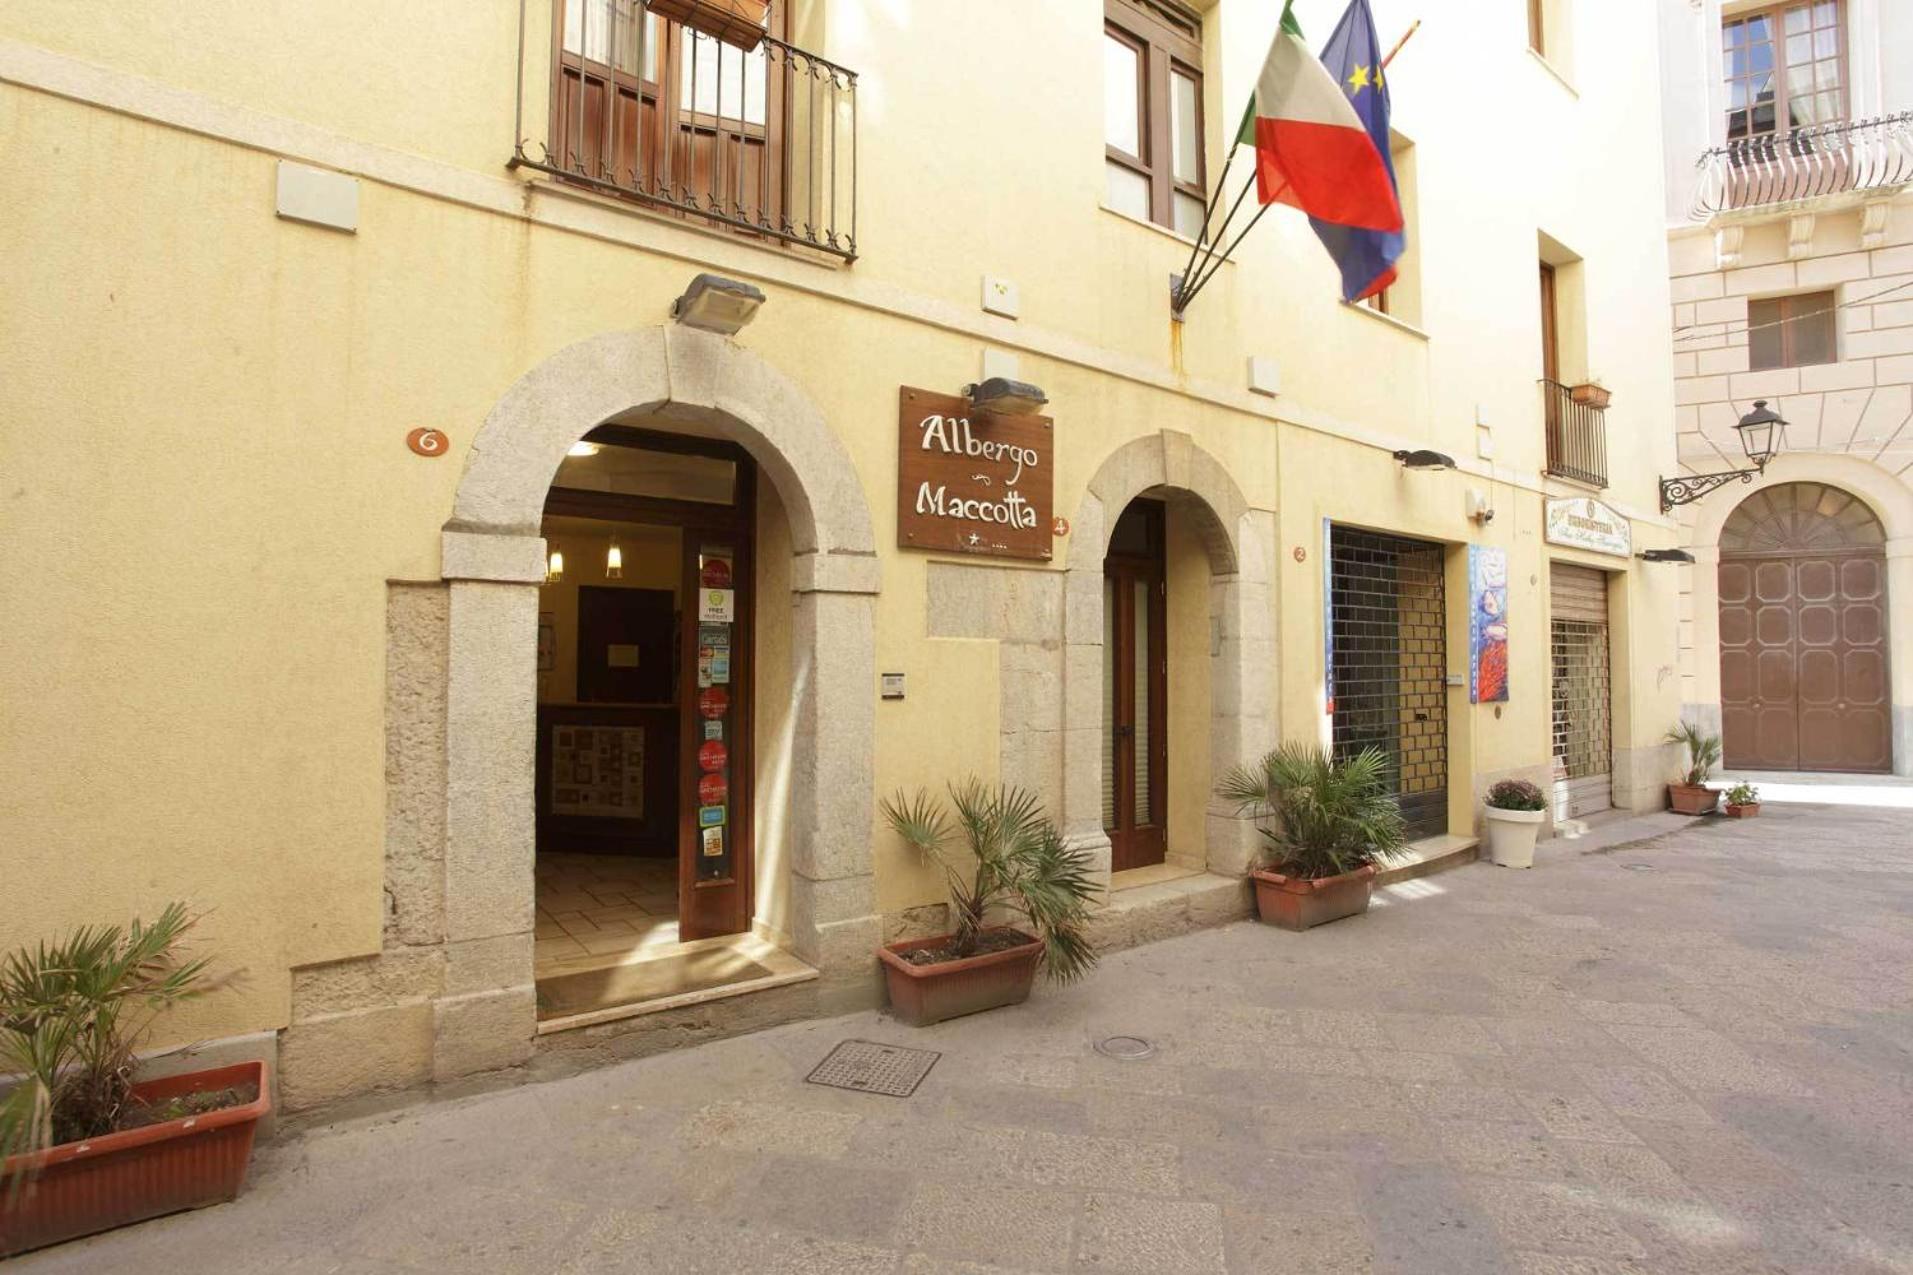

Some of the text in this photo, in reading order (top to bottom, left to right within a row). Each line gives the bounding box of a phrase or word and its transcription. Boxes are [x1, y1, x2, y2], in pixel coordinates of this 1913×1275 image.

[419, 431, 438, 451] 6
[920, 415, 1038, 486] Albergo
[915, 481, 1037, 530] Maccotta
[1054, 519, 1066, 535] 4
